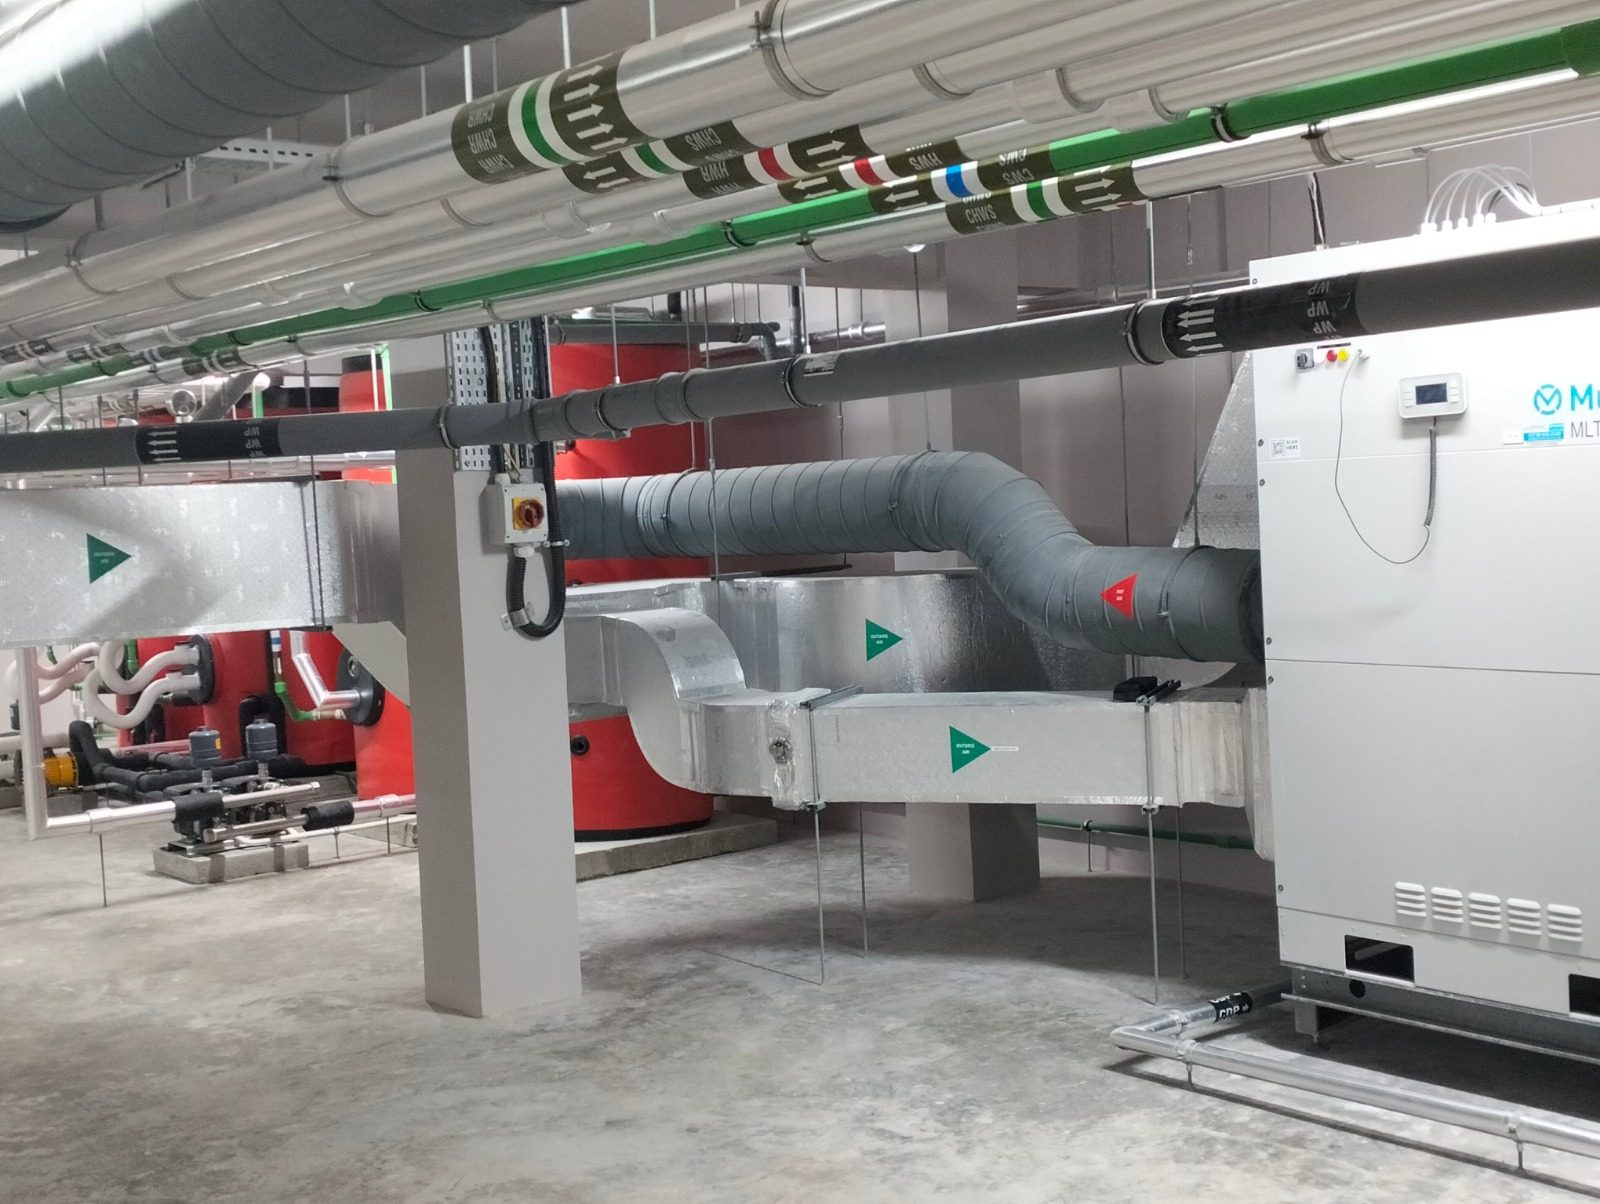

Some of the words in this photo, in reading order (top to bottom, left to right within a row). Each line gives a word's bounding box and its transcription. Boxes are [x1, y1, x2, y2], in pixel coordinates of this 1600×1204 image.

[467, 128, 497, 154] CHWR
[685, 127, 722, 151] CHWS
[908, 152, 942, 170] HWS
[700, 160, 729, 182] HWR
[1002, 167, 1034, 185] CWS
[964, 204, 998, 224] CHWS
[1307, 281, 1330, 296] WP
[1307, 300, 1330, 317] WP
[1312, 320, 1337, 334] WP
[1569, 383, 1600, 411] M
[245, 438, 262, 449] WP
